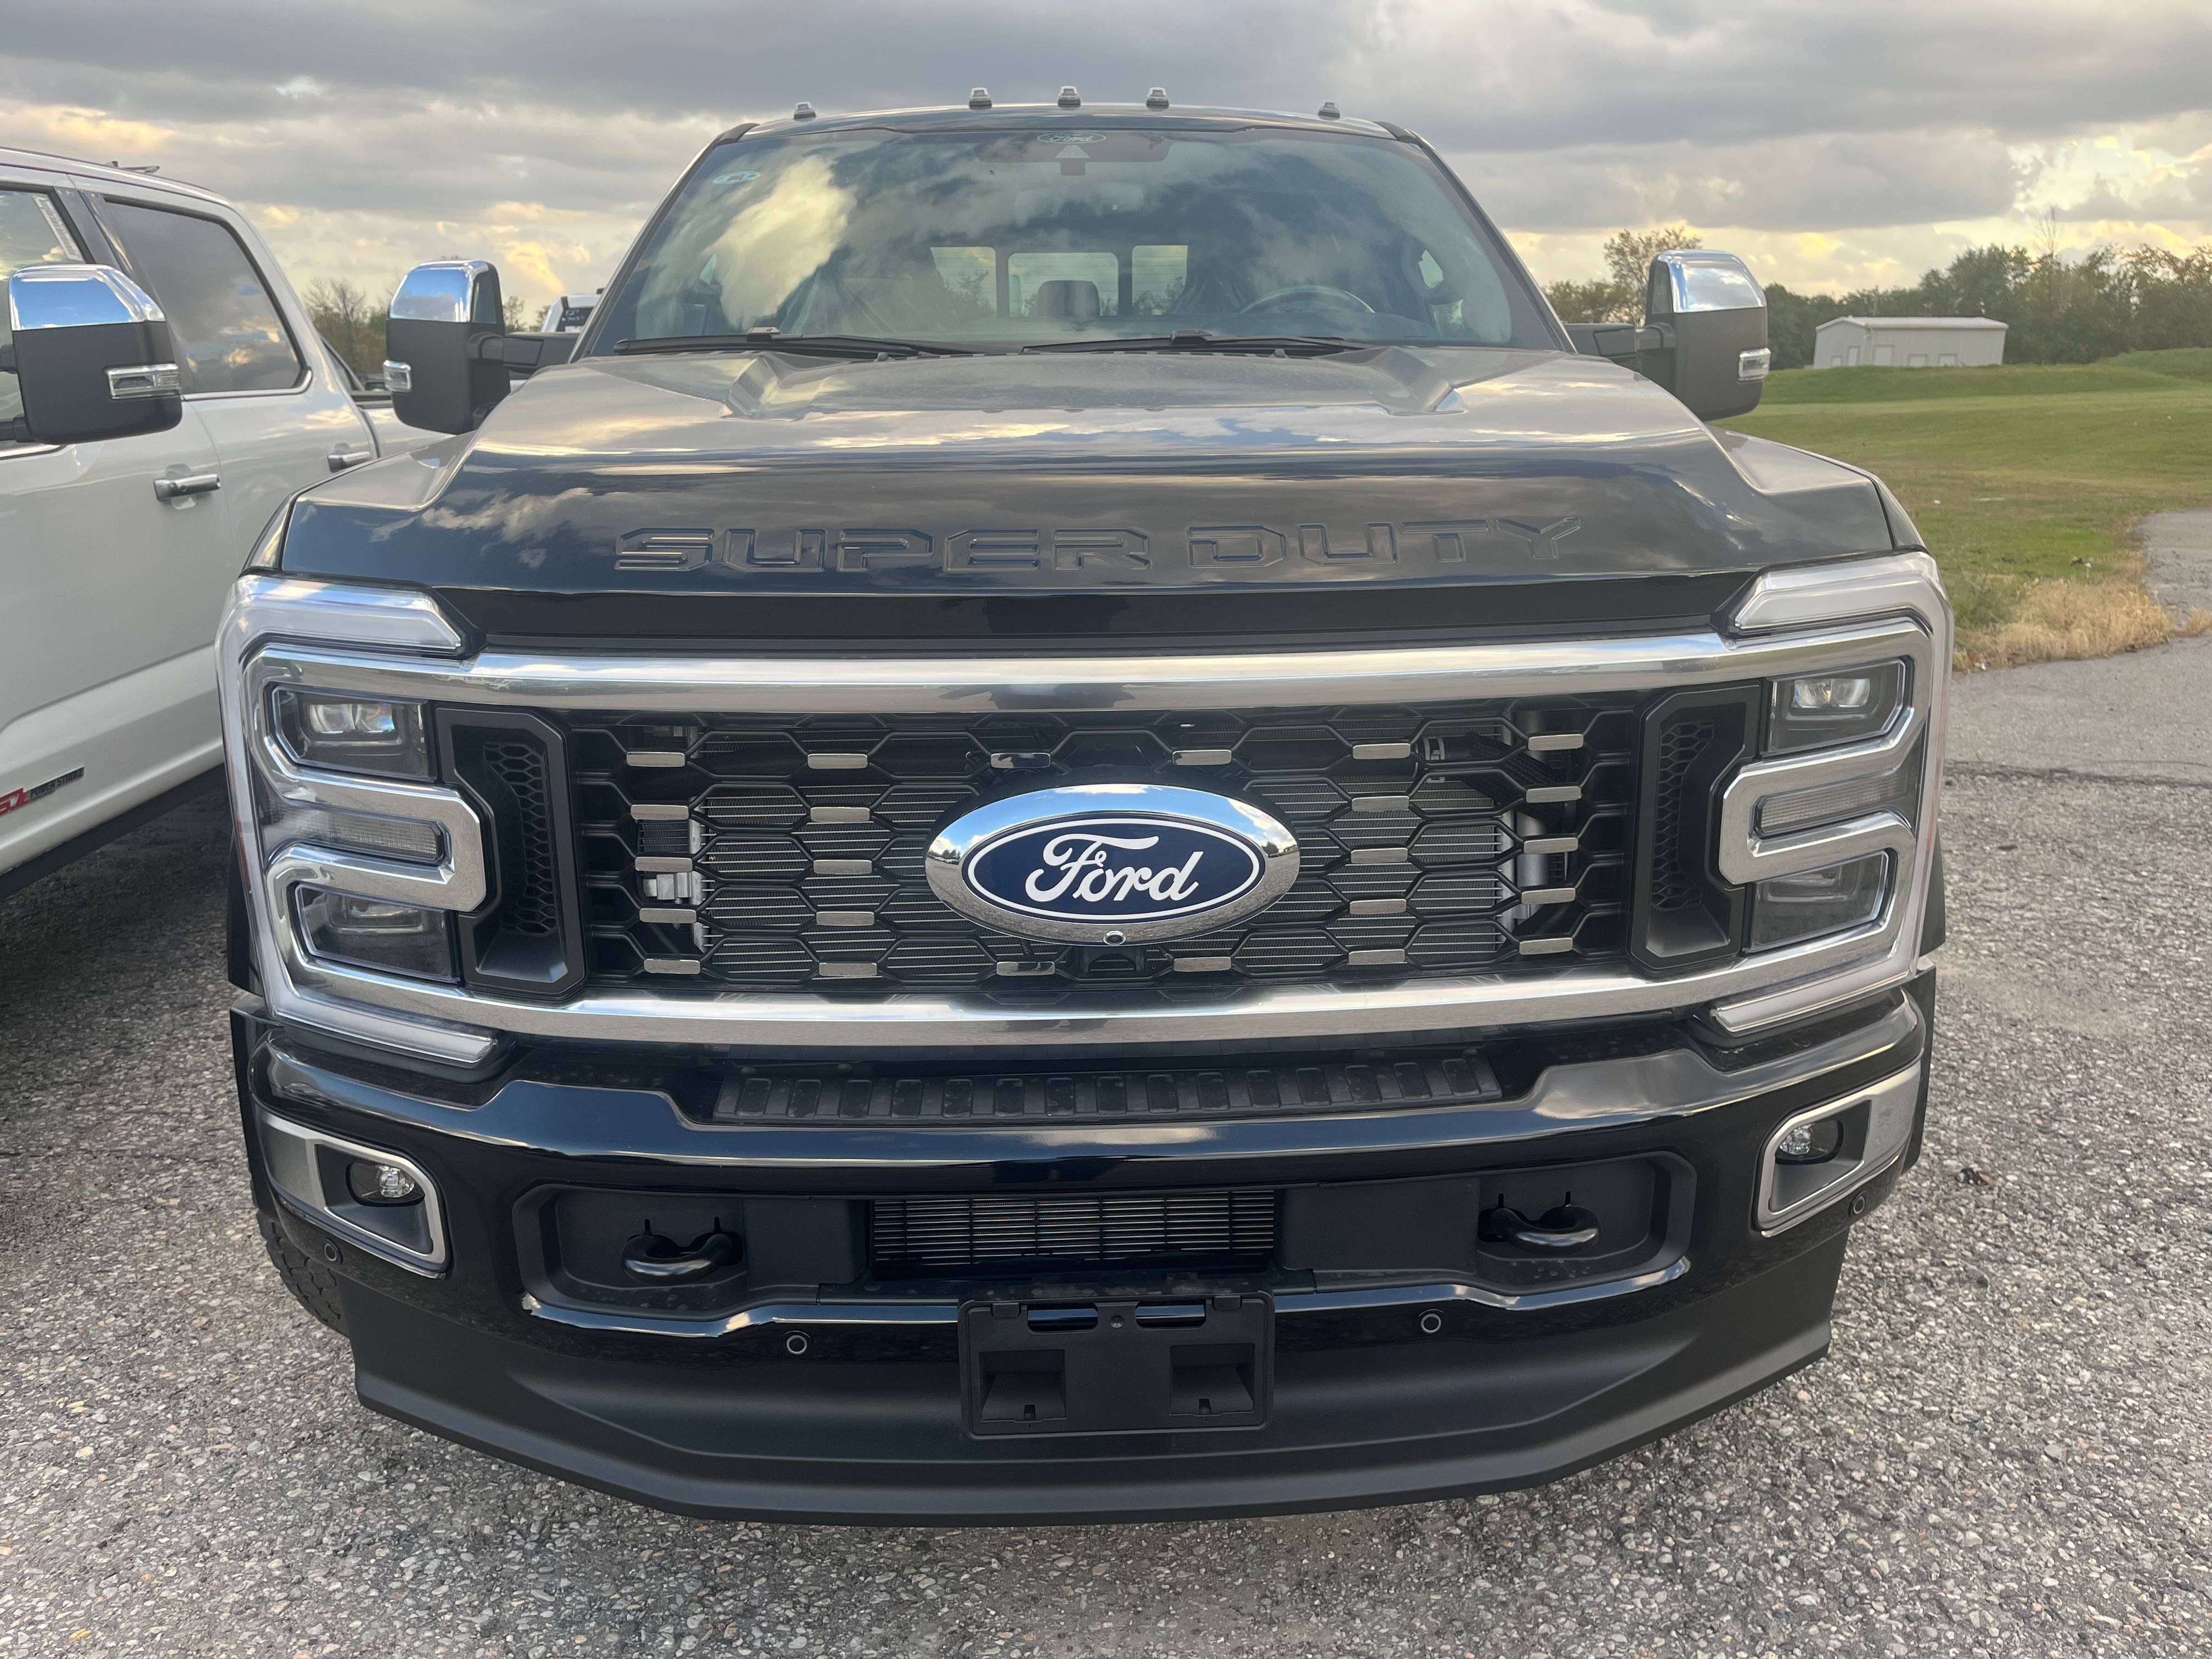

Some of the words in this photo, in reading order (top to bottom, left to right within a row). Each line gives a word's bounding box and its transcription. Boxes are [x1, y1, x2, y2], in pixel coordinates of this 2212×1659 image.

[1049, 133, 1093, 142] Ford
[614, 528, 1150, 572] SUPER
[1186, 517, 1582, 569] DUTY
[1025, 833, 1203, 901] Ford
